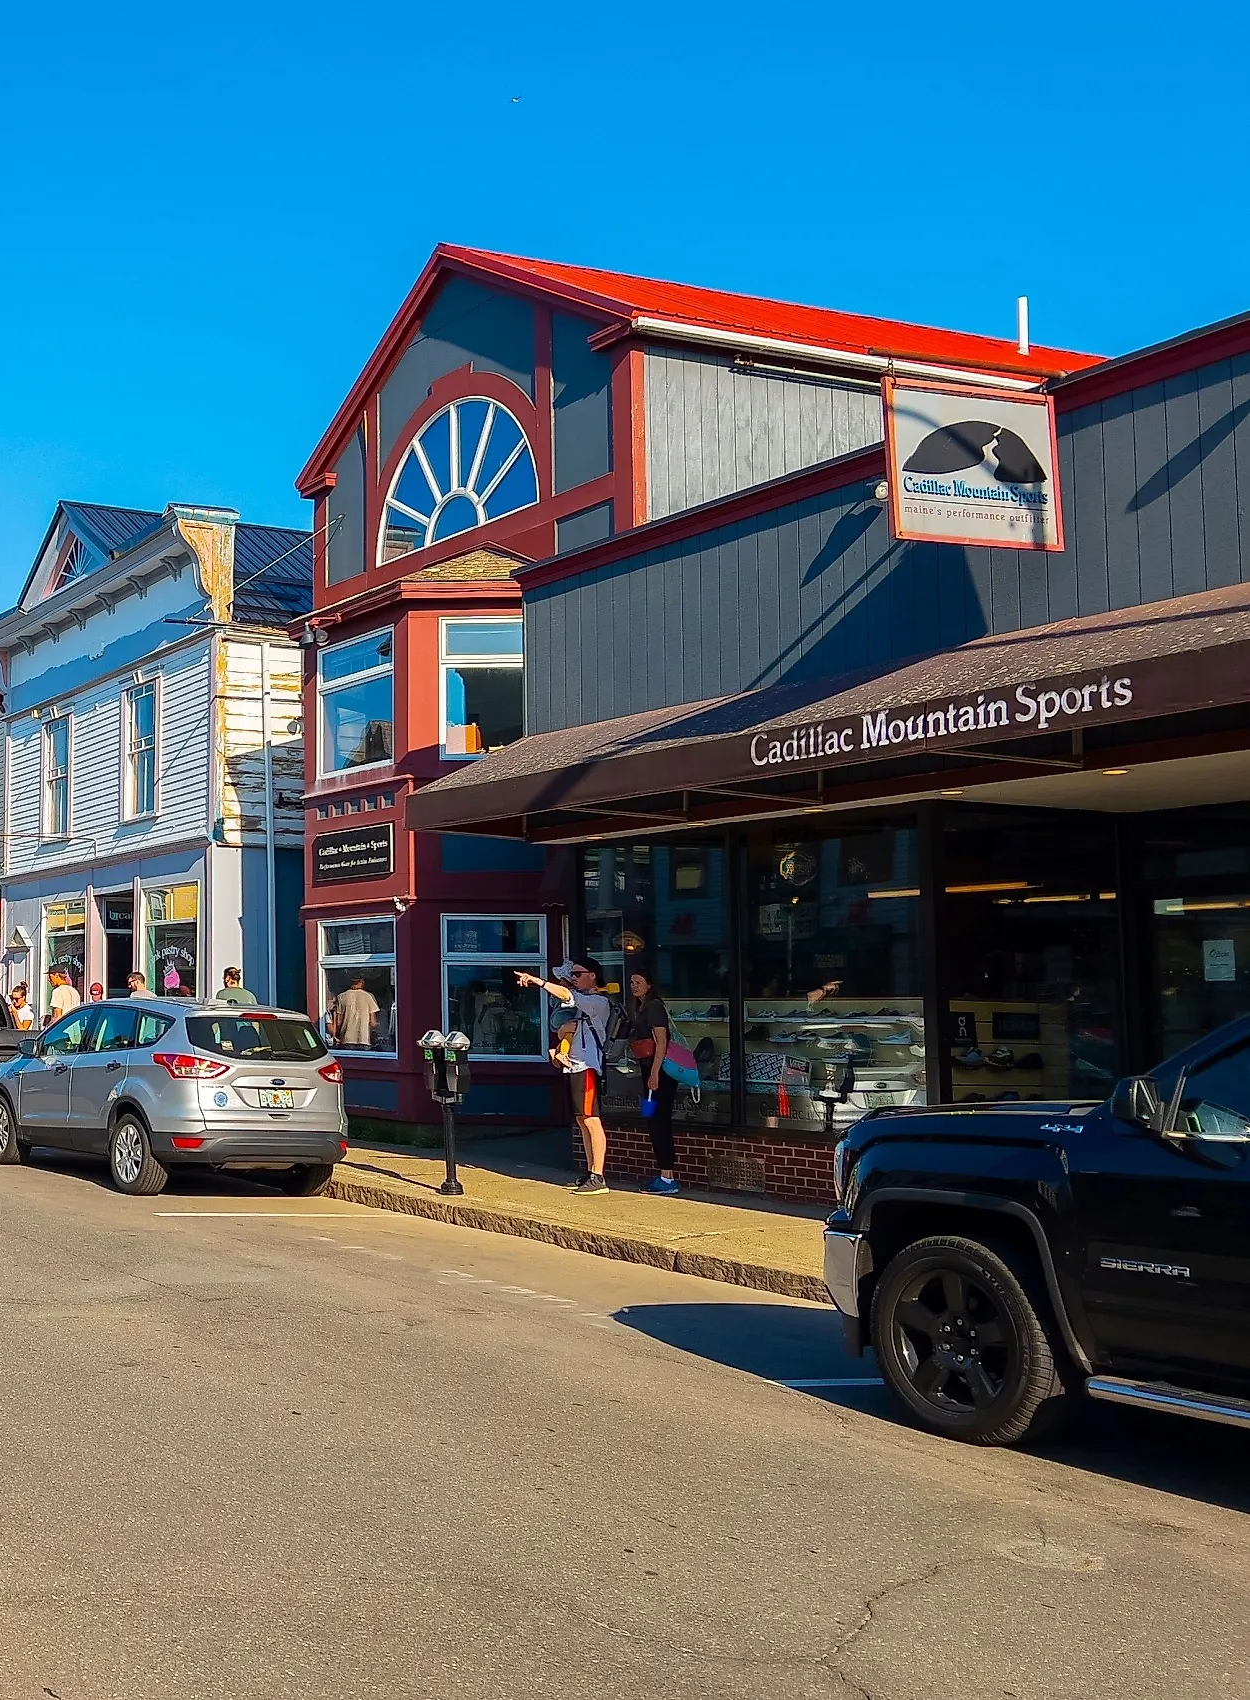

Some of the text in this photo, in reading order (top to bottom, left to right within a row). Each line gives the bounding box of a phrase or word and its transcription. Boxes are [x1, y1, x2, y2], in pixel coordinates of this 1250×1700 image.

[904, 475, 1049, 506] Cadillac Mountain Sports
[904, 505, 1049, 524] maine's performance outfitter
[749, 674, 1134, 767] Cadillac Mountain Sports
[161, 945, 180, 959] pastry
[180, 948, 195, 967] shop
[1209, 948, 1230, 959] Open
[1100, 1257, 1191, 1278] SIERRA
